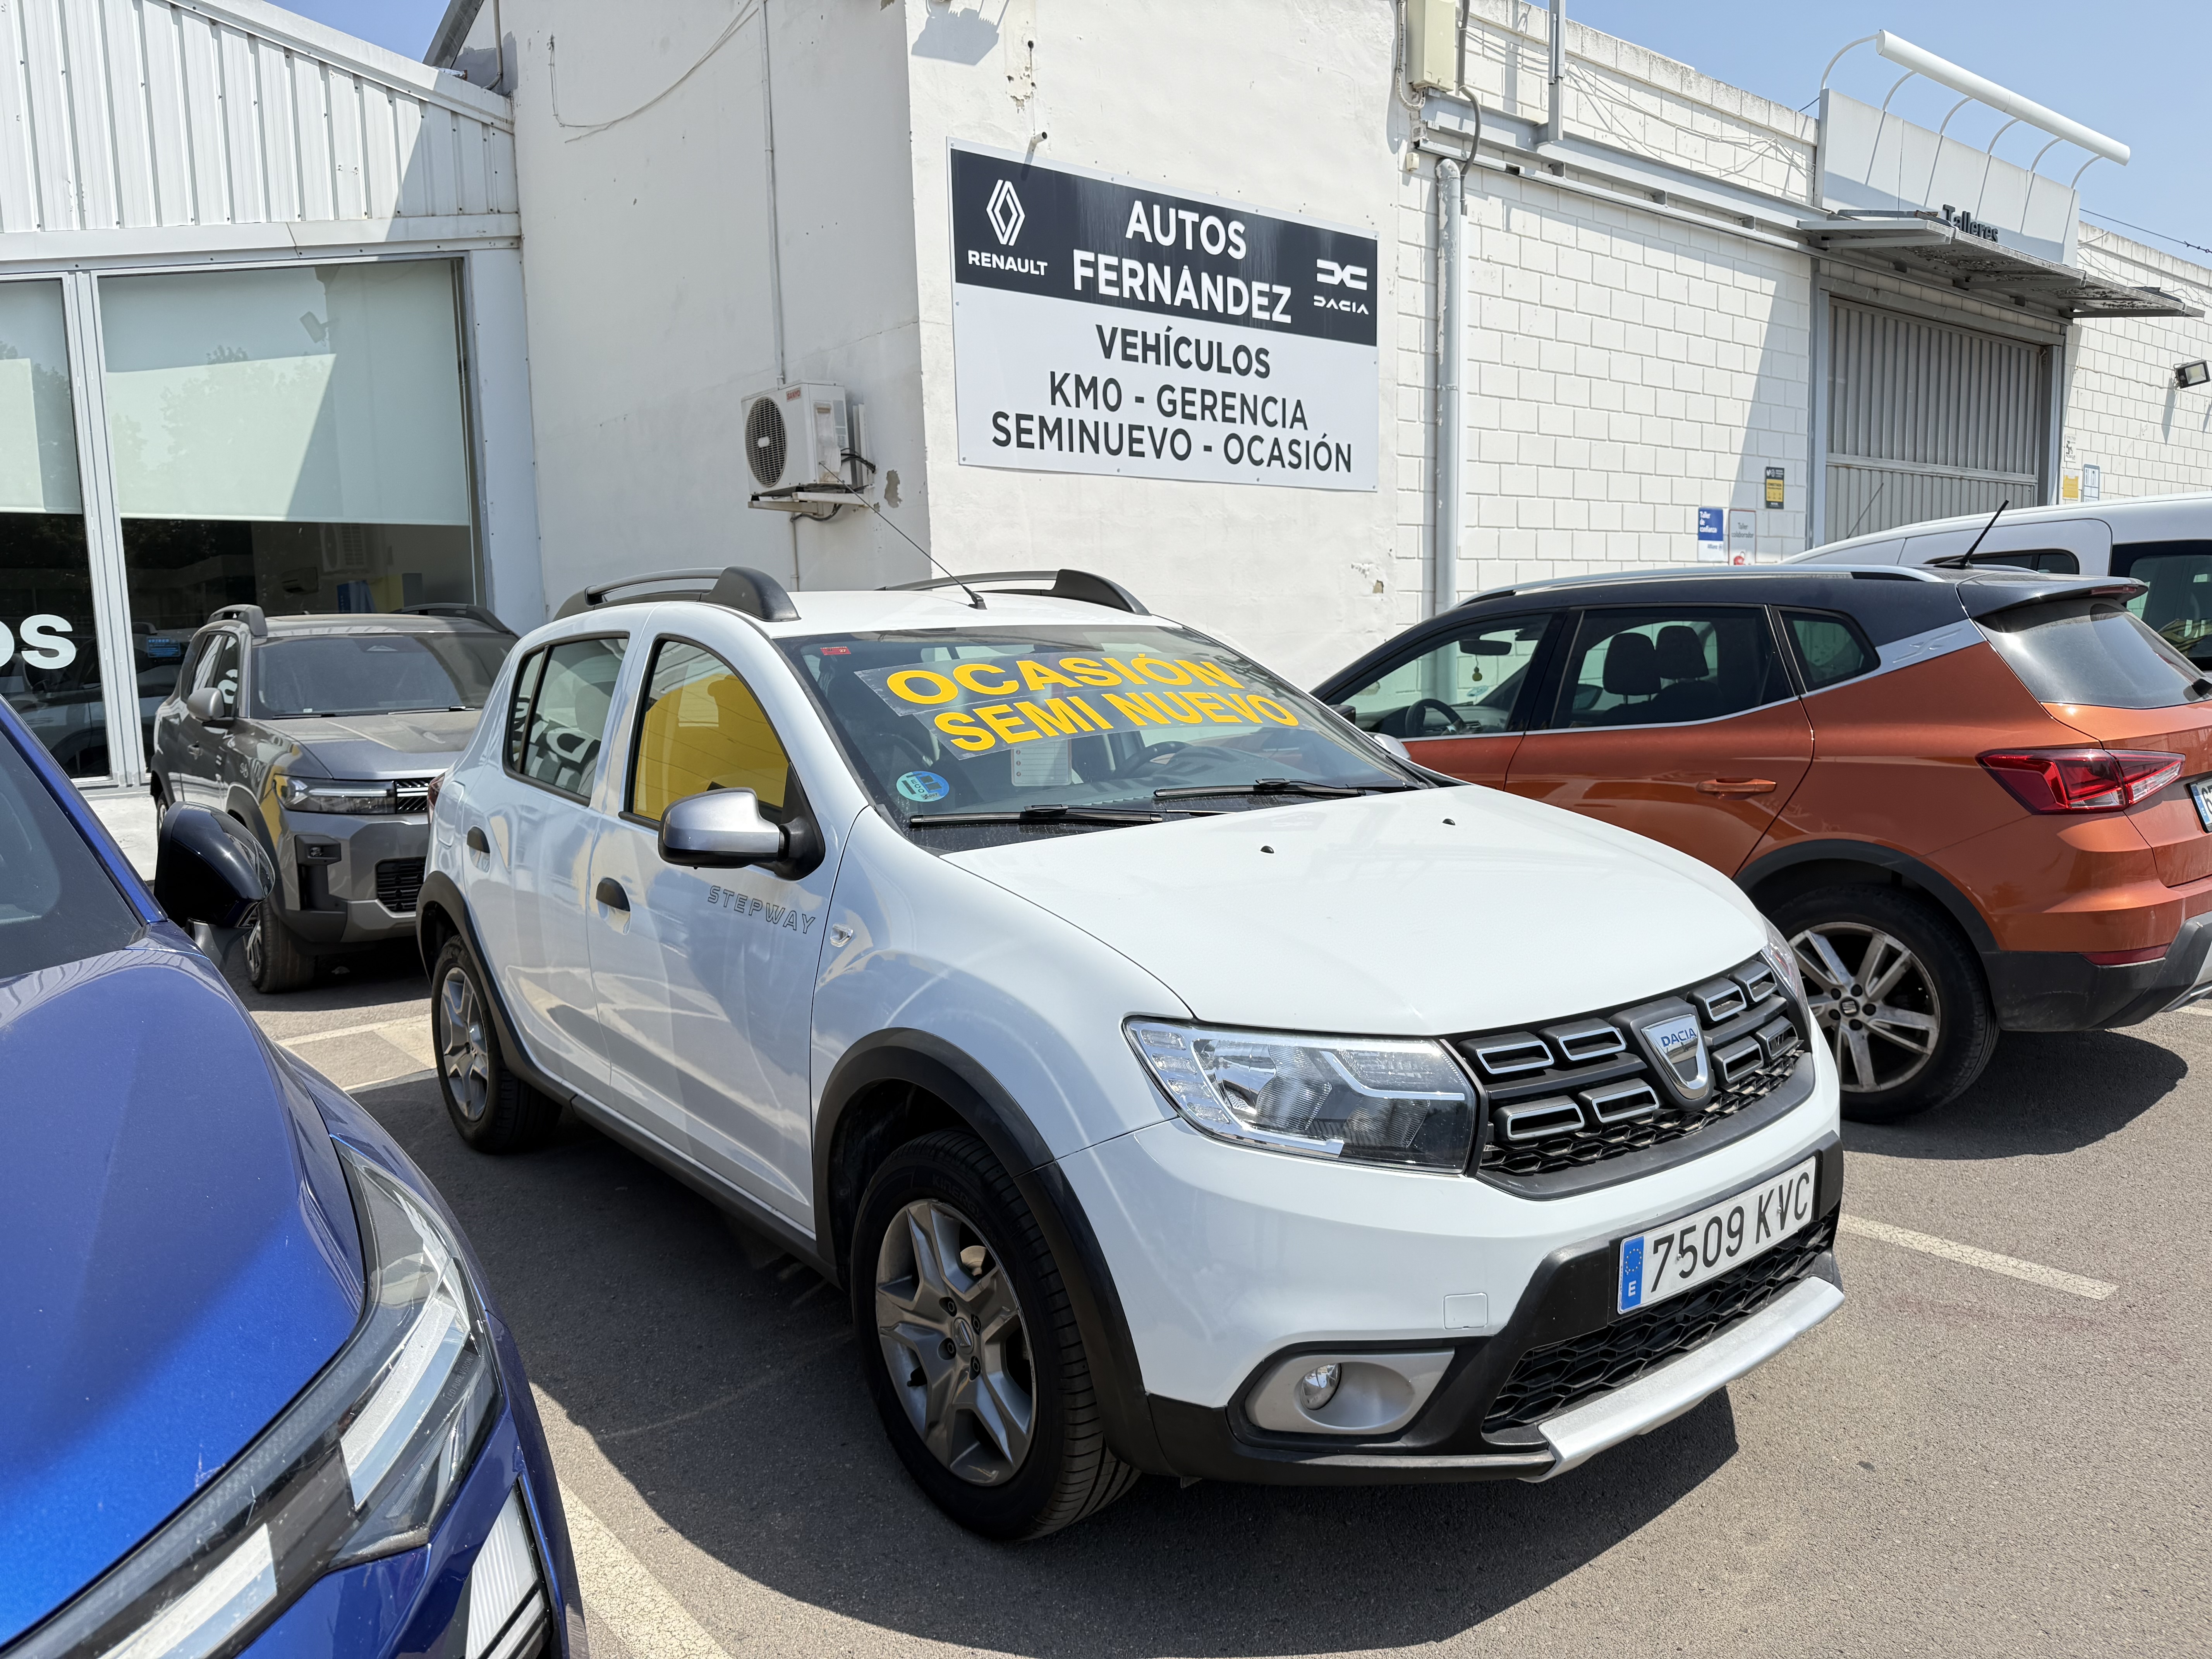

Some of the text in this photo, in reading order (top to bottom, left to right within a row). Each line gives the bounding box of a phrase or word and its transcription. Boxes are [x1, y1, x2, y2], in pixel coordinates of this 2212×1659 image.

[1125, 200, 1247, 259] AUTOS
[1943, 204, 1998, 243] Talleres
[968, 250, 1048, 276] RENAULT
[1314, 295, 1369, 315] DACIA
[1095, 325, 1270, 378] VEHÍCULOS
[787, 389, 801, 400] SANYO
[1157, 385, 1307, 431] GERENCIA
[992, 411, 1191, 461] SEMINUEVO
[1223, 433, 1351, 473] OCASIÓN
[886, 653, 1245, 704] OCASIÓN
[934, 691, 1299, 751] SEMI NUEVO
[910, 779, 924, 793] ECO
[708, 885, 816, 934] STEPWAY
[1661, 1028, 1697, 1047] DACIA
[1651, 1171, 1810, 1293] 7509 KVC
[1628, 1280, 1636, 1297] E
[452, 1374, 464, 1391] PURE
